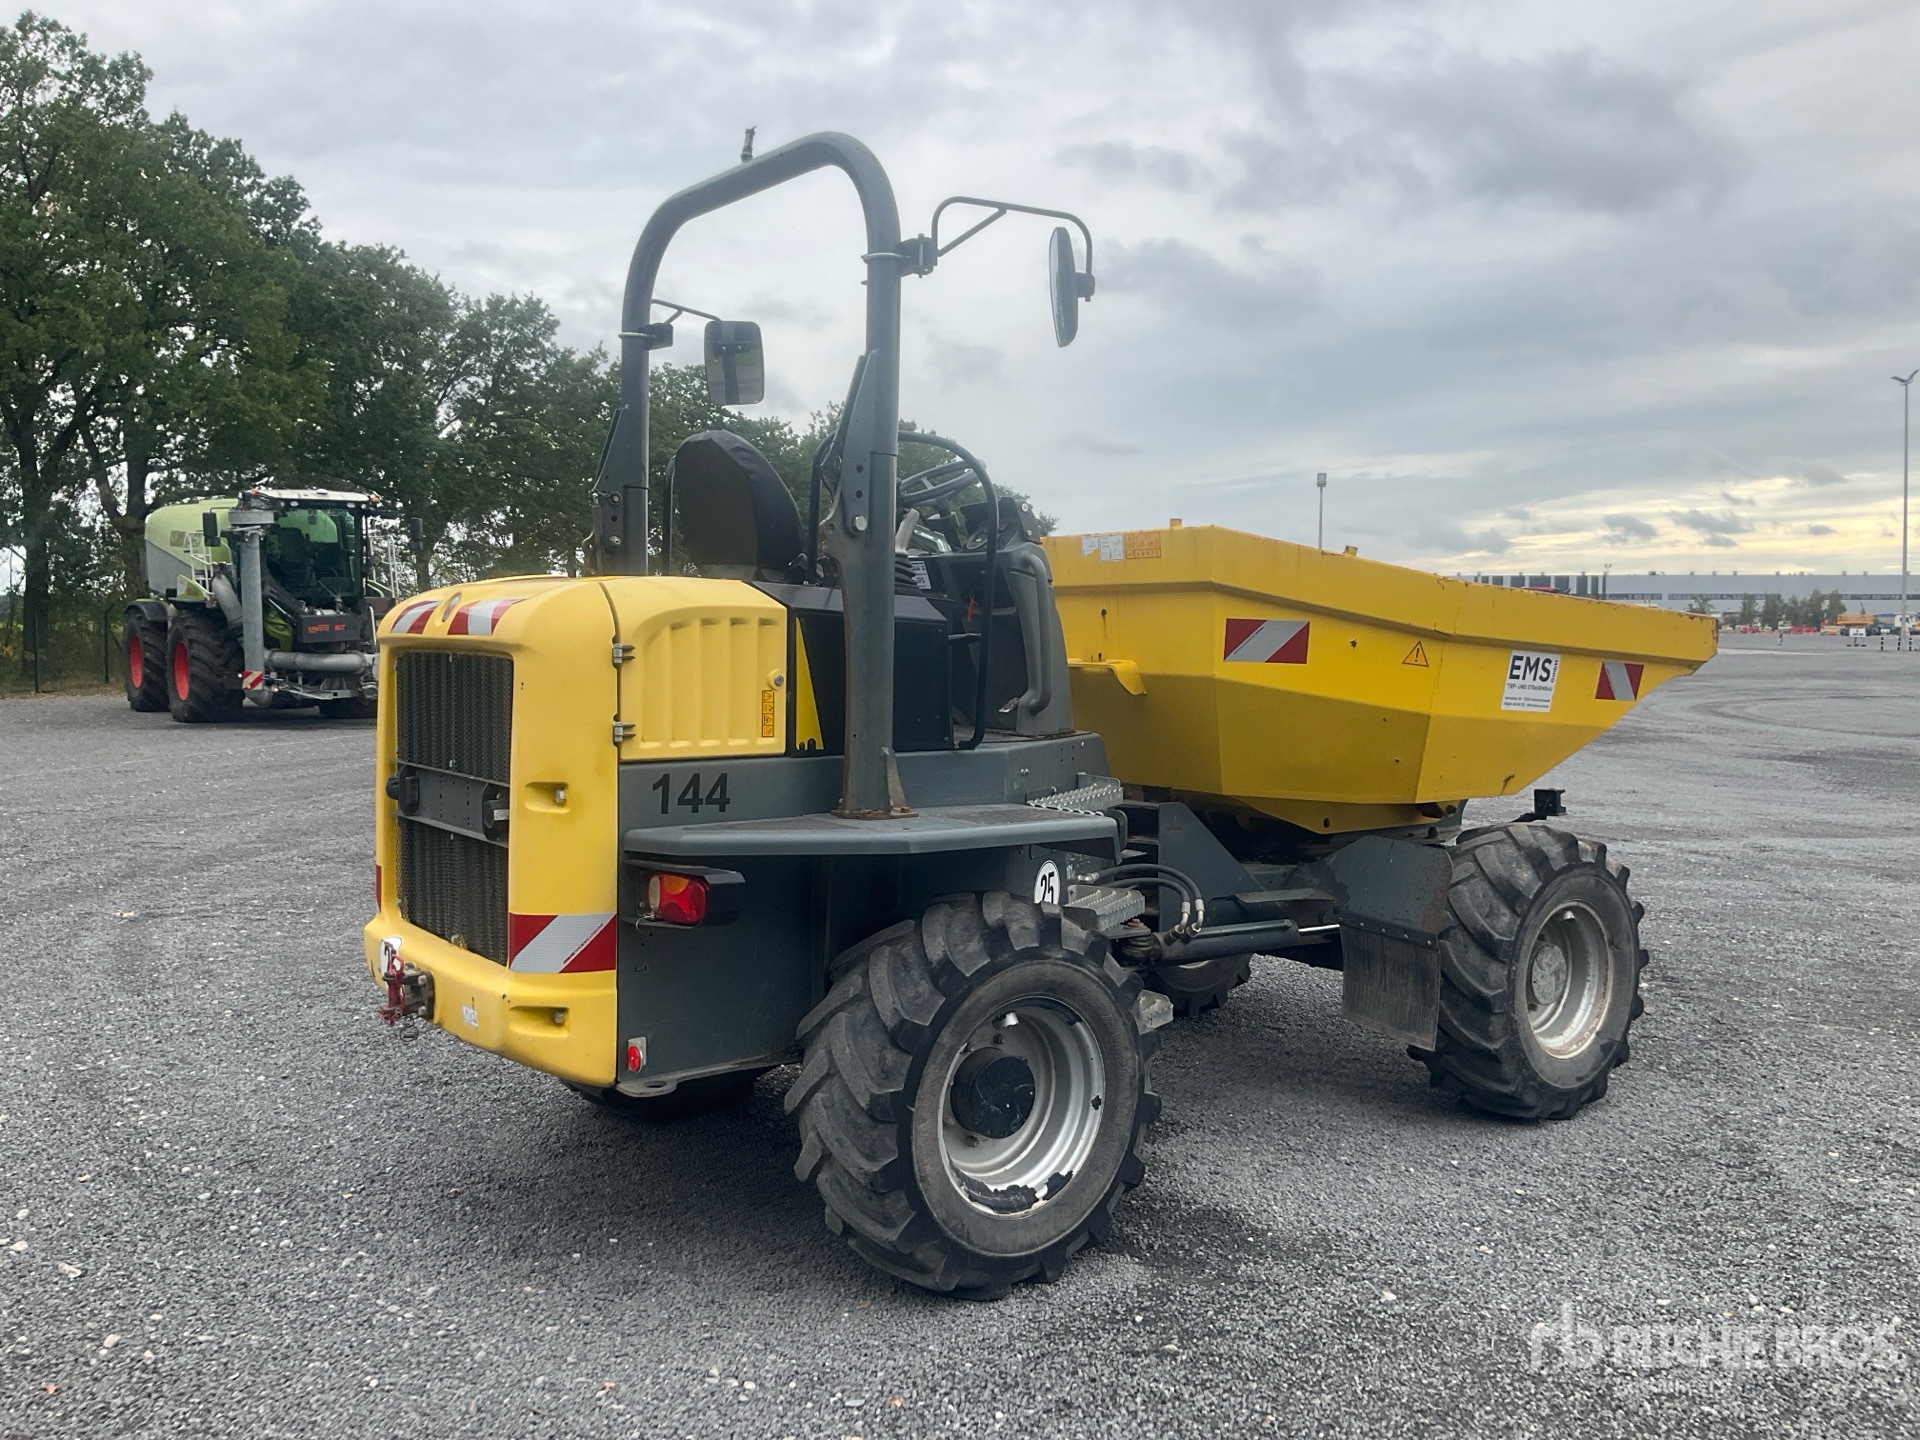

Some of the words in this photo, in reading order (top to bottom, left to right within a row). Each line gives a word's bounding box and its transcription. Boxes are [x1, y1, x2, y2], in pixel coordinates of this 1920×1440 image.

[1508, 655, 1552, 682] EMS
[652, 772, 731, 815] 144
[1040, 870, 1055, 904] 25
